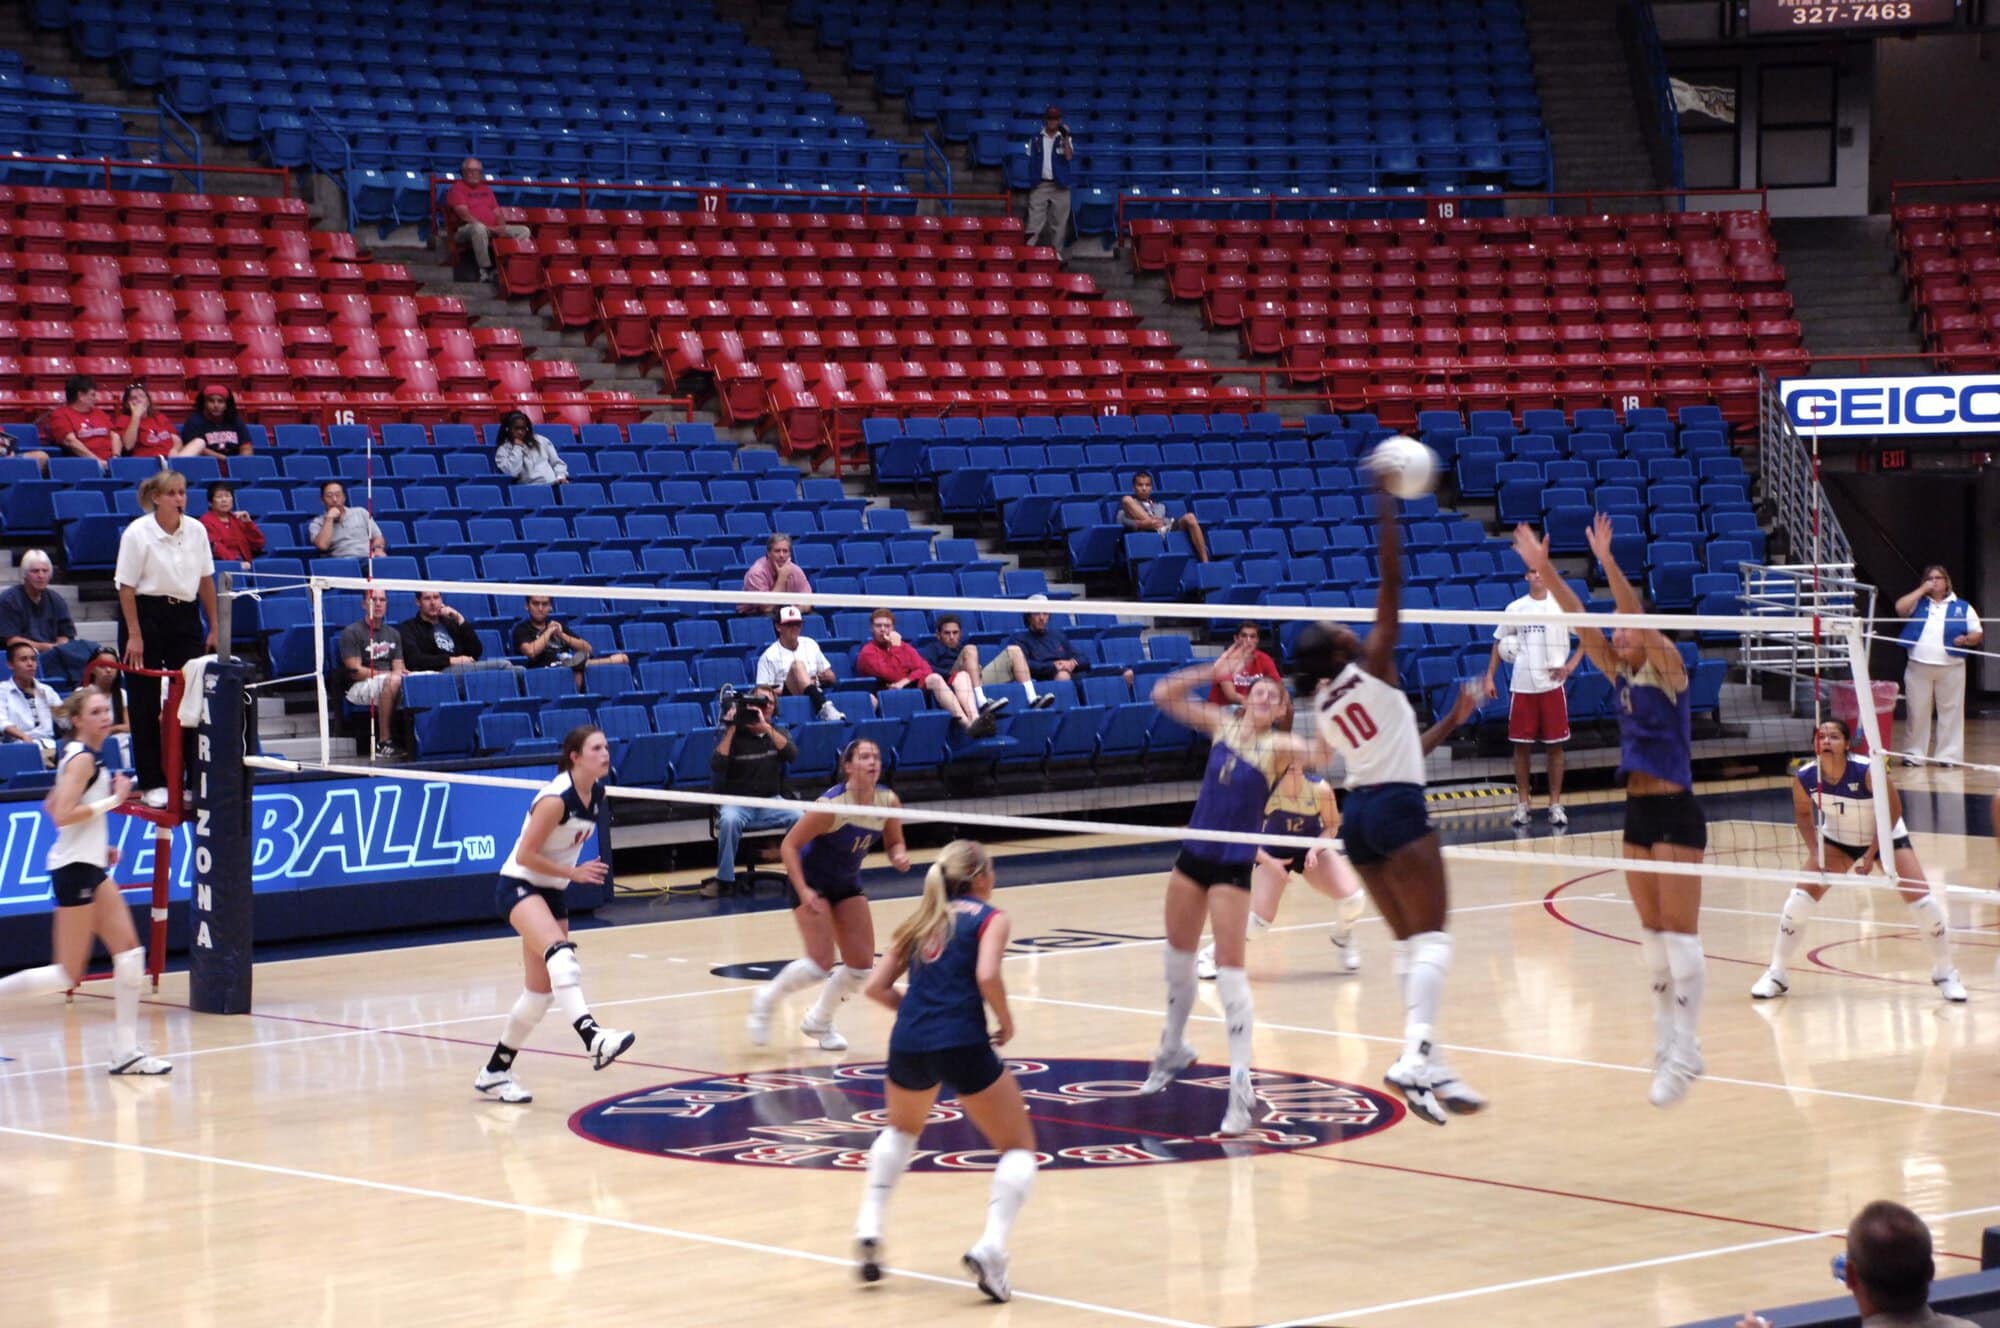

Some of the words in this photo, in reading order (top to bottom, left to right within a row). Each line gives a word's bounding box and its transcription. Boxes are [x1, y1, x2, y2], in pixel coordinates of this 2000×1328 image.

[1792, 3, 1912, 24] 327-7463
[704, 195, 718, 212] 17
[1438, 203, 1454, 218] 18
[1622, 395, 1640, 412] 18
[1786, 384, 2000, 428] GEICO
[335, 410, 355, 426] 16
[1882, 449, 1905, 469] EXIT
[1332, 702, 1378, 749] 10
[1832, 801, 1845, 815] 7
[195, 697, 213, 949] ARIZONA
[1286, 817, 1304, 833] 12
